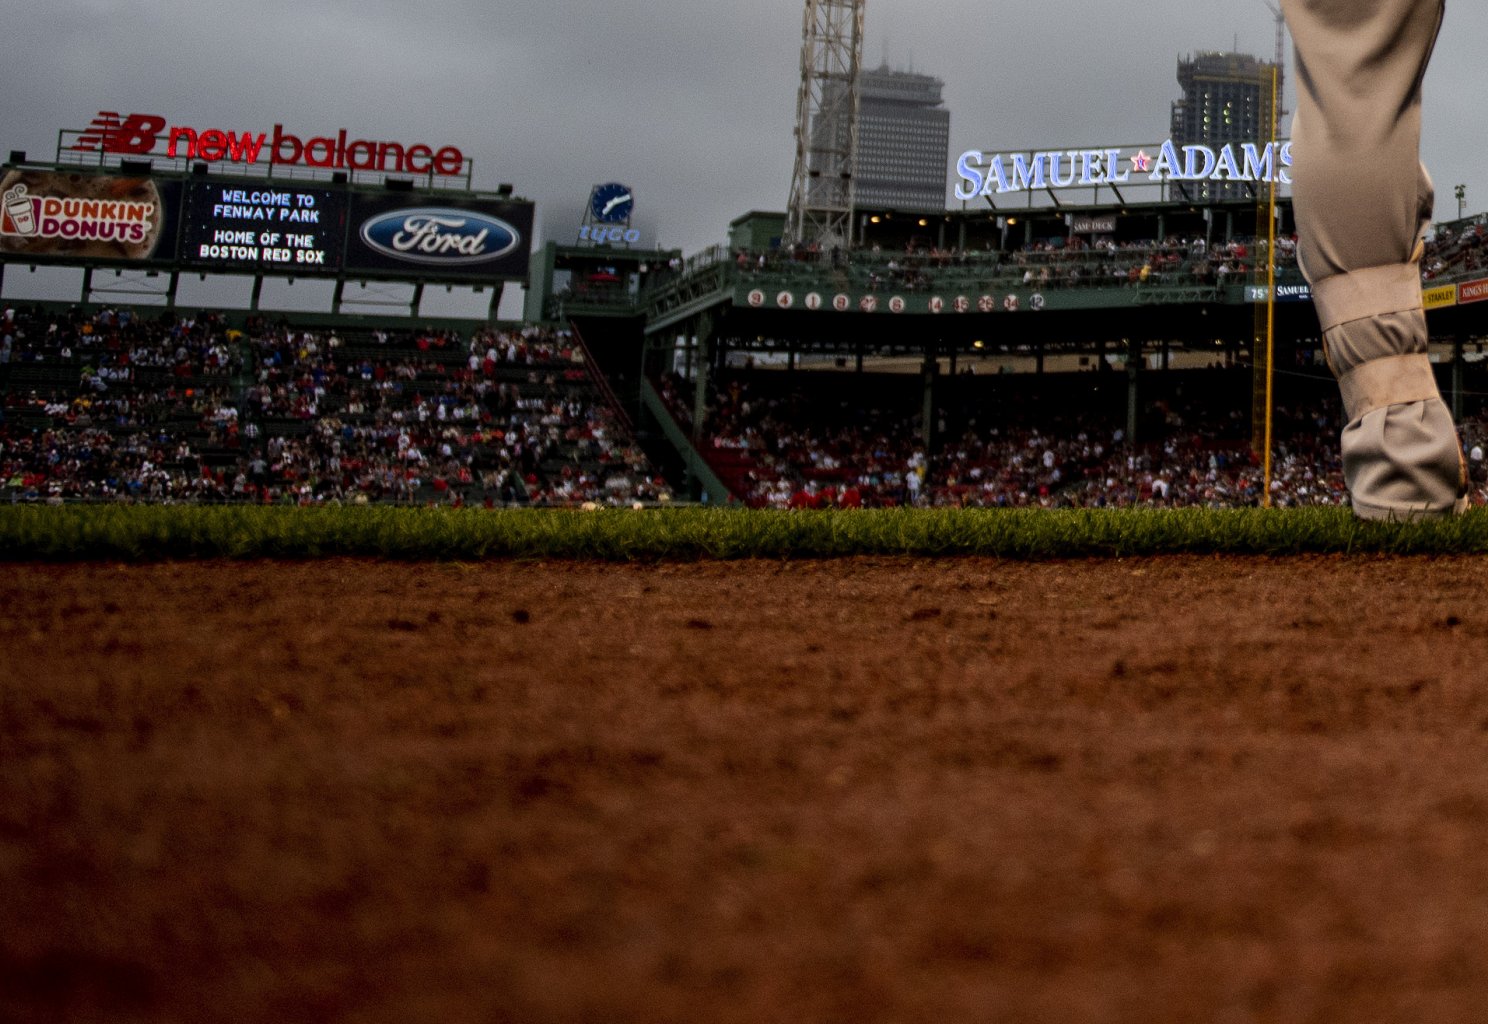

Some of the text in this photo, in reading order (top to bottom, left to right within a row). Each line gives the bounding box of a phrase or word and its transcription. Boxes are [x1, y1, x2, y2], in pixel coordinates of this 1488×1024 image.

[166, 123, 463, 176] new balance
[954, 149, 1130, 200] SAMUEL
[222, 189, 315, 207] WELCOME TO
[44, 199, 153, 222] DUNKIN'
[213, 204, 320, 223] FENWAY PARK
[42, 218, 145, 241] DONUTS
[214, 229, 314, 248] HOME OF THE
[392, 214, 488, 256] Ford
[579, 225, 641, 244] tyco
[200, 244, 325, 264] BOSTON RED SOX
[1277, 285, 1309, 297] SAMUEL
[1427, 290, 1453, 304] STANLEY
[927, 297, 942, 311] 14
[977, 298, 994, 311] 26
[1029, 295, 1044, 309] 42
